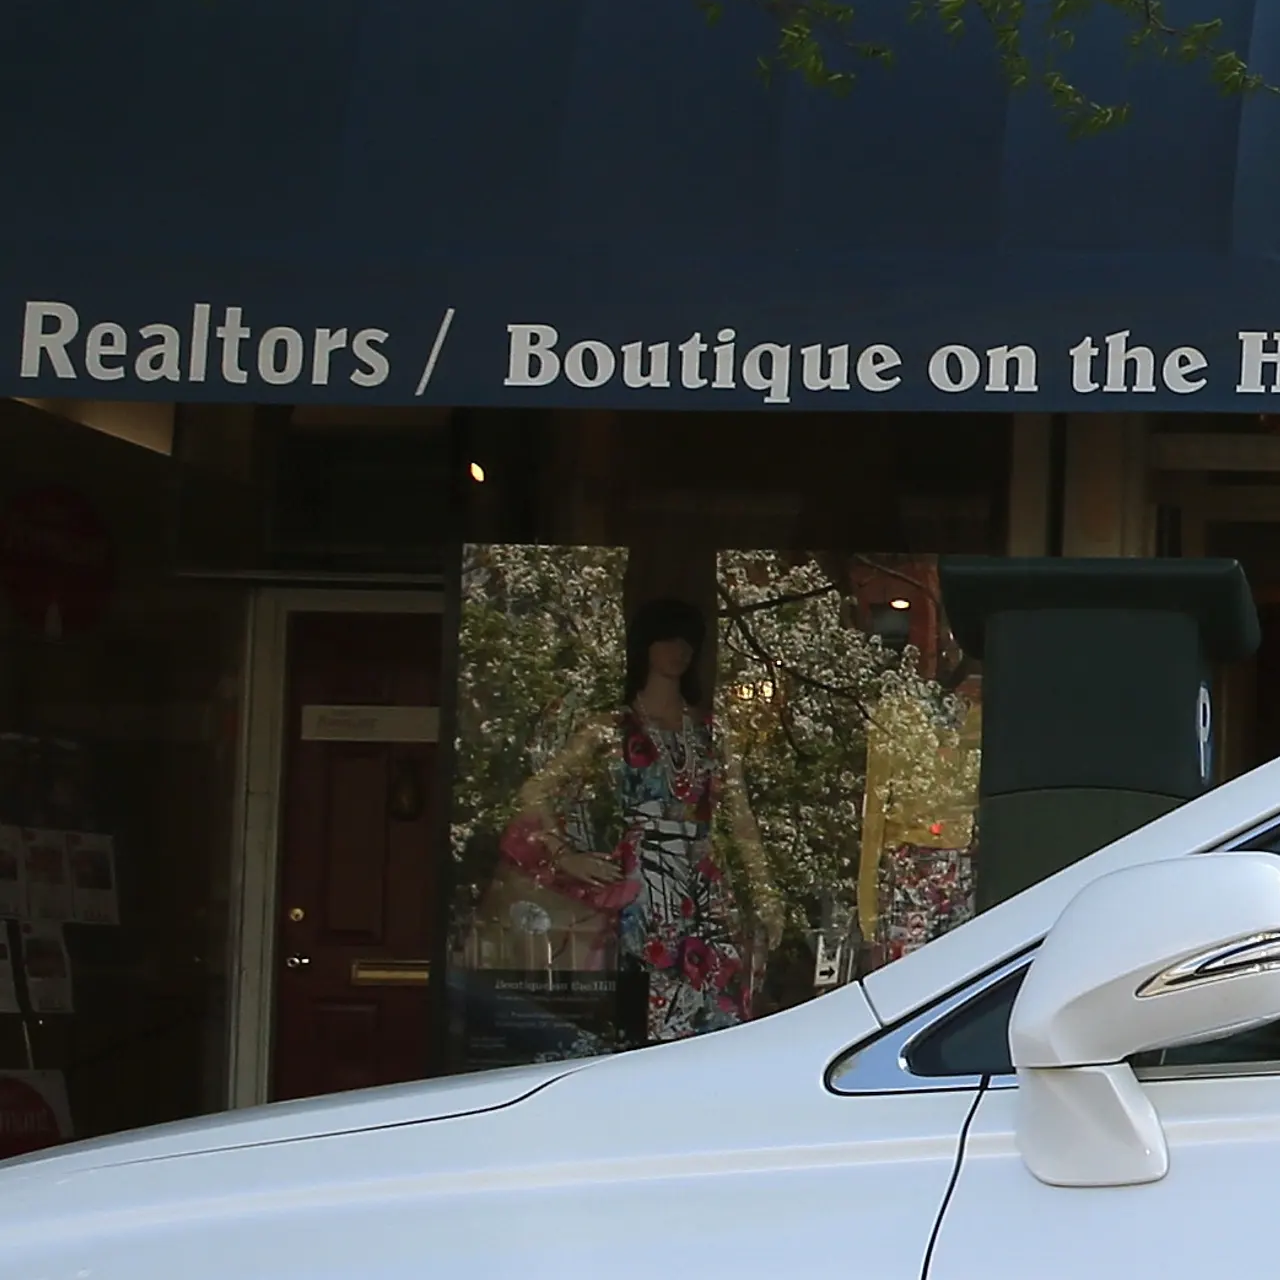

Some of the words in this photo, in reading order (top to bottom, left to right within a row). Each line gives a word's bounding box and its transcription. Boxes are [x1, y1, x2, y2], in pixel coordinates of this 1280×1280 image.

[20, 301, 390, 387] Realtors
[415, 308, 455, 396] /
[503, 324, 902, 401] Boutique
[928, 344, 1039, 393] on
[1069, 329, 1208, 394] the
